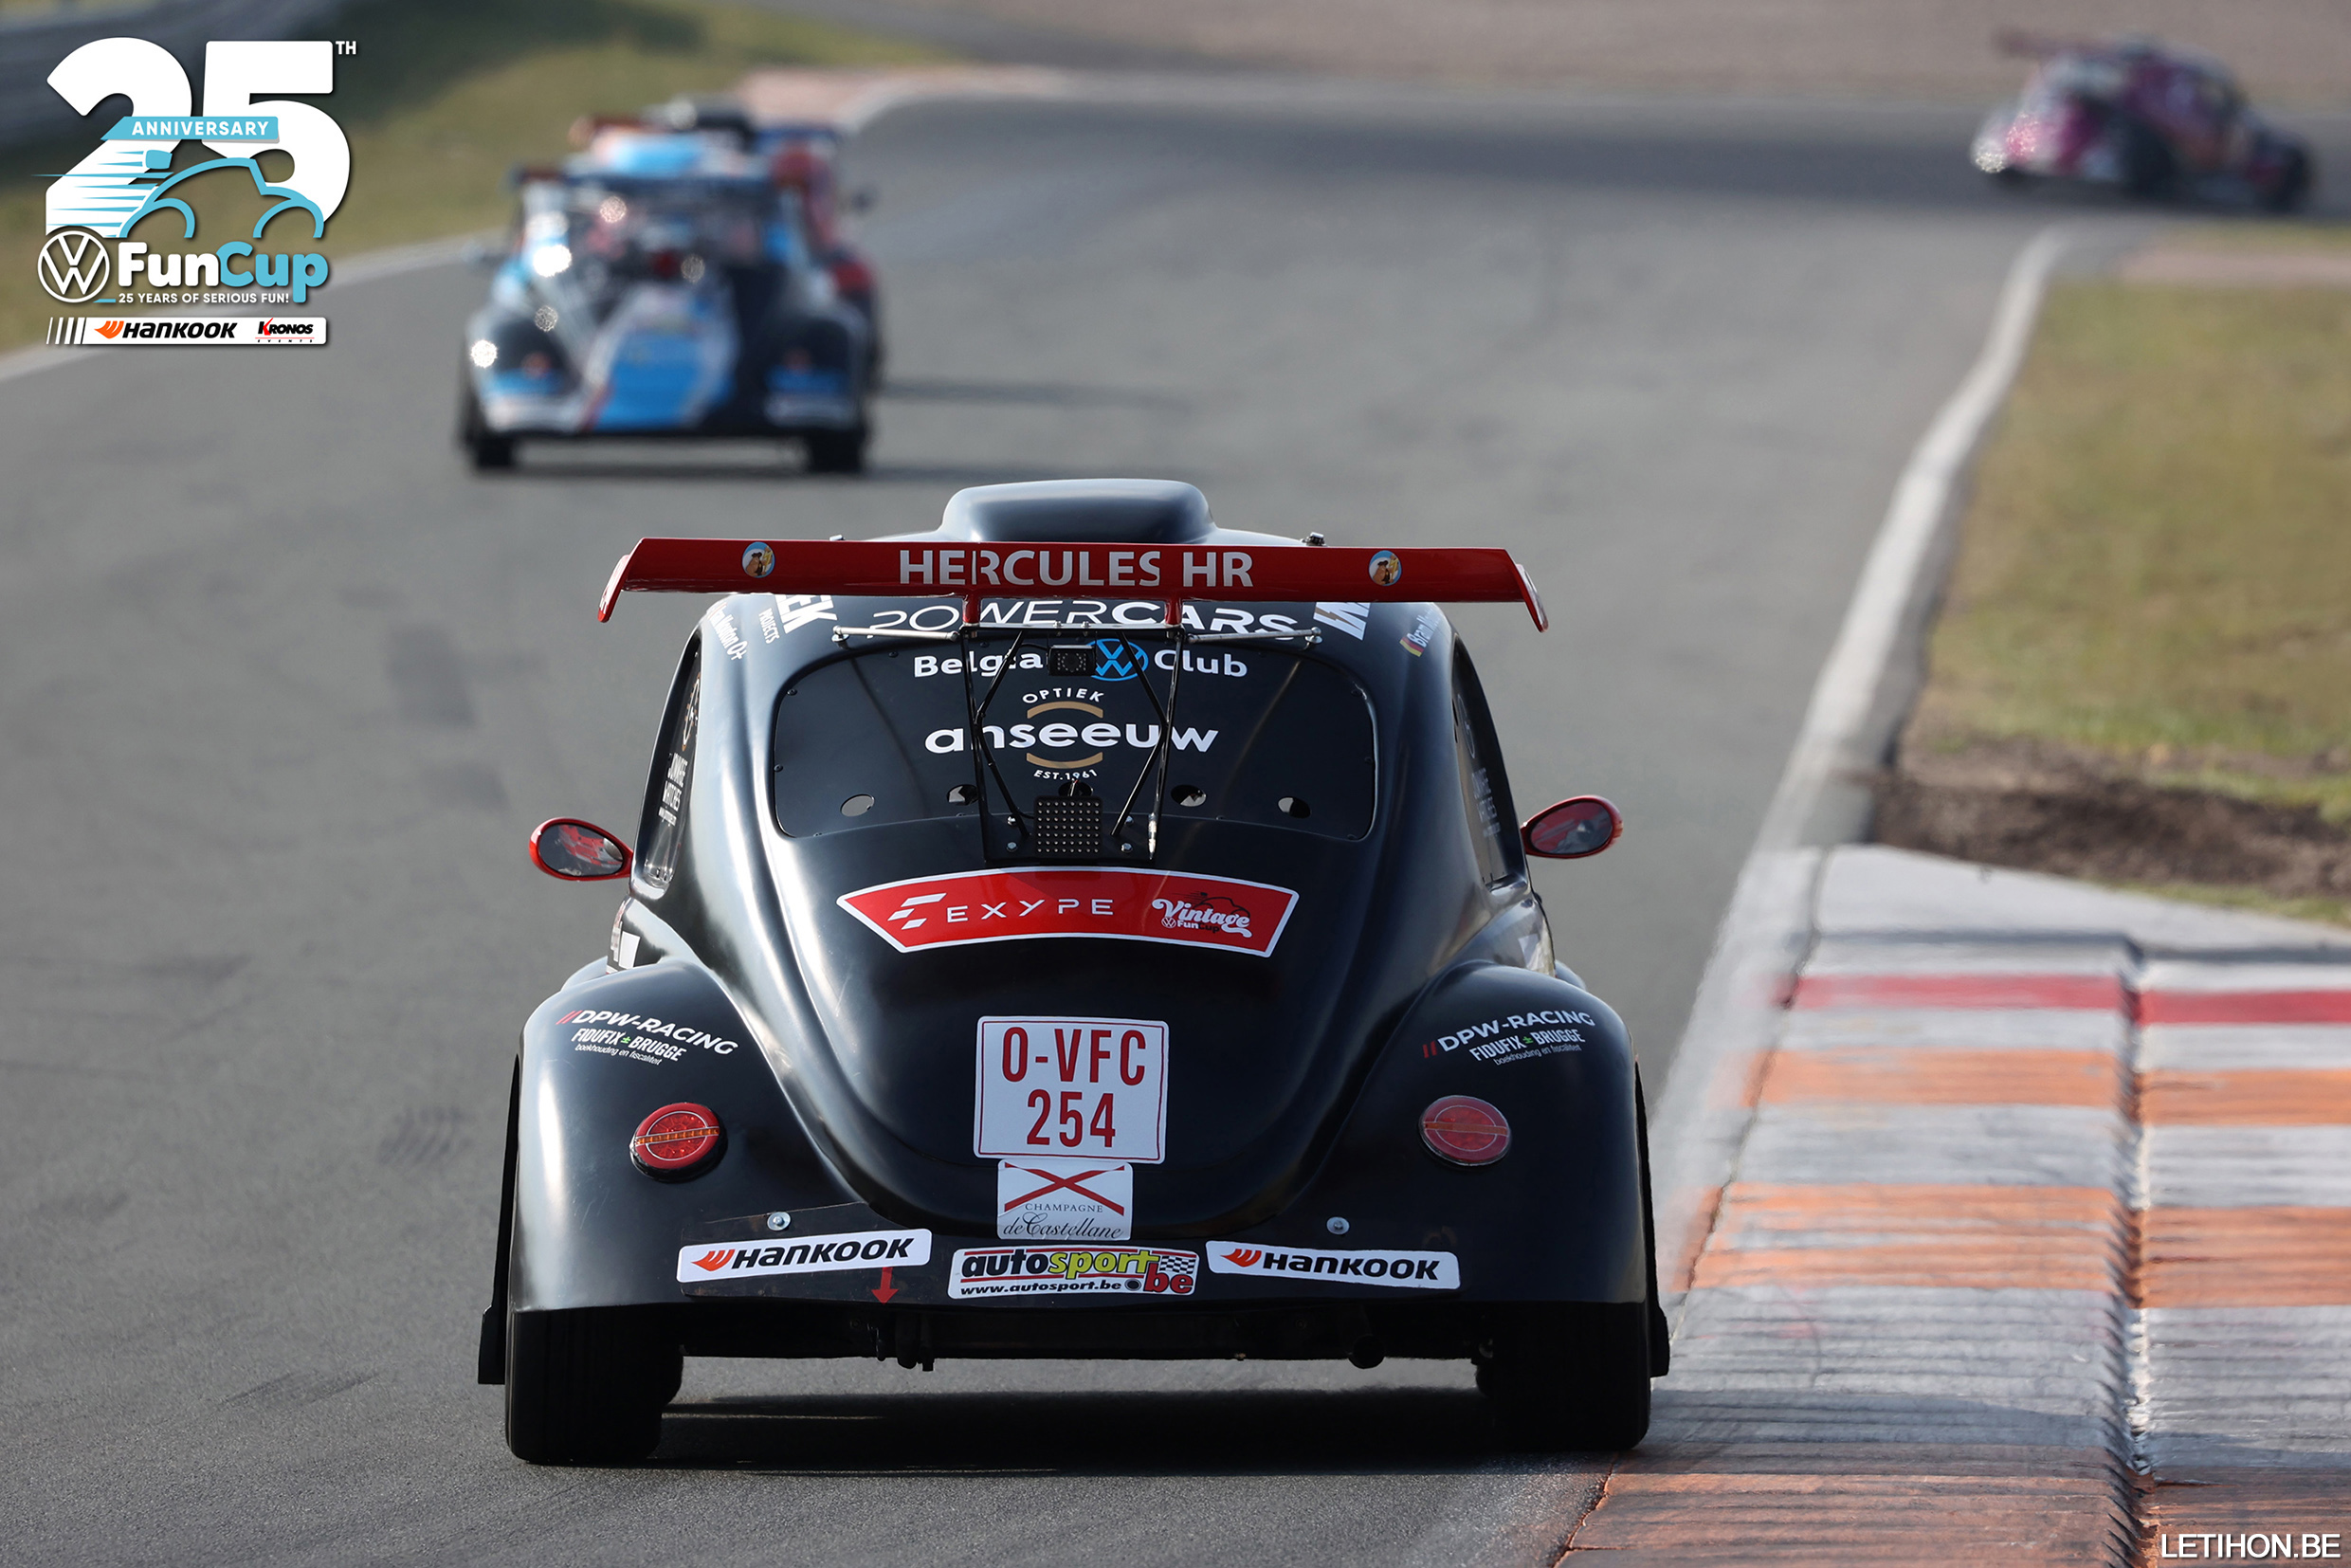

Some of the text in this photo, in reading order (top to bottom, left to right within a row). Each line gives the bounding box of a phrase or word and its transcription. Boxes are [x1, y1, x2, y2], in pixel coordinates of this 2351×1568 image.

[899, 549, 1254, 588] HERCULES HR
[758, 607, 780, 645] PROJECTS
[1154, 648, 1248, 679] Club
[1022, 686, 1105, 703] OPTIEK
[923, 721, 1220, 754] anseeuw
[946, 898, 1115, 923] EXYPE
[1151, 898, 1253, 939] Vintage
[571, 1028, 687, 1062] FIDUFIX BRUGGE
[1468, 1029, 1586, 1062] FIDUFIX BRUGGE
[1026, 1088, 1117, 1148] 254
[1025, 1203, 1103, 1213] CHAMPAGNE
[960, 1279, 1122, 1295] www.autosport.be
